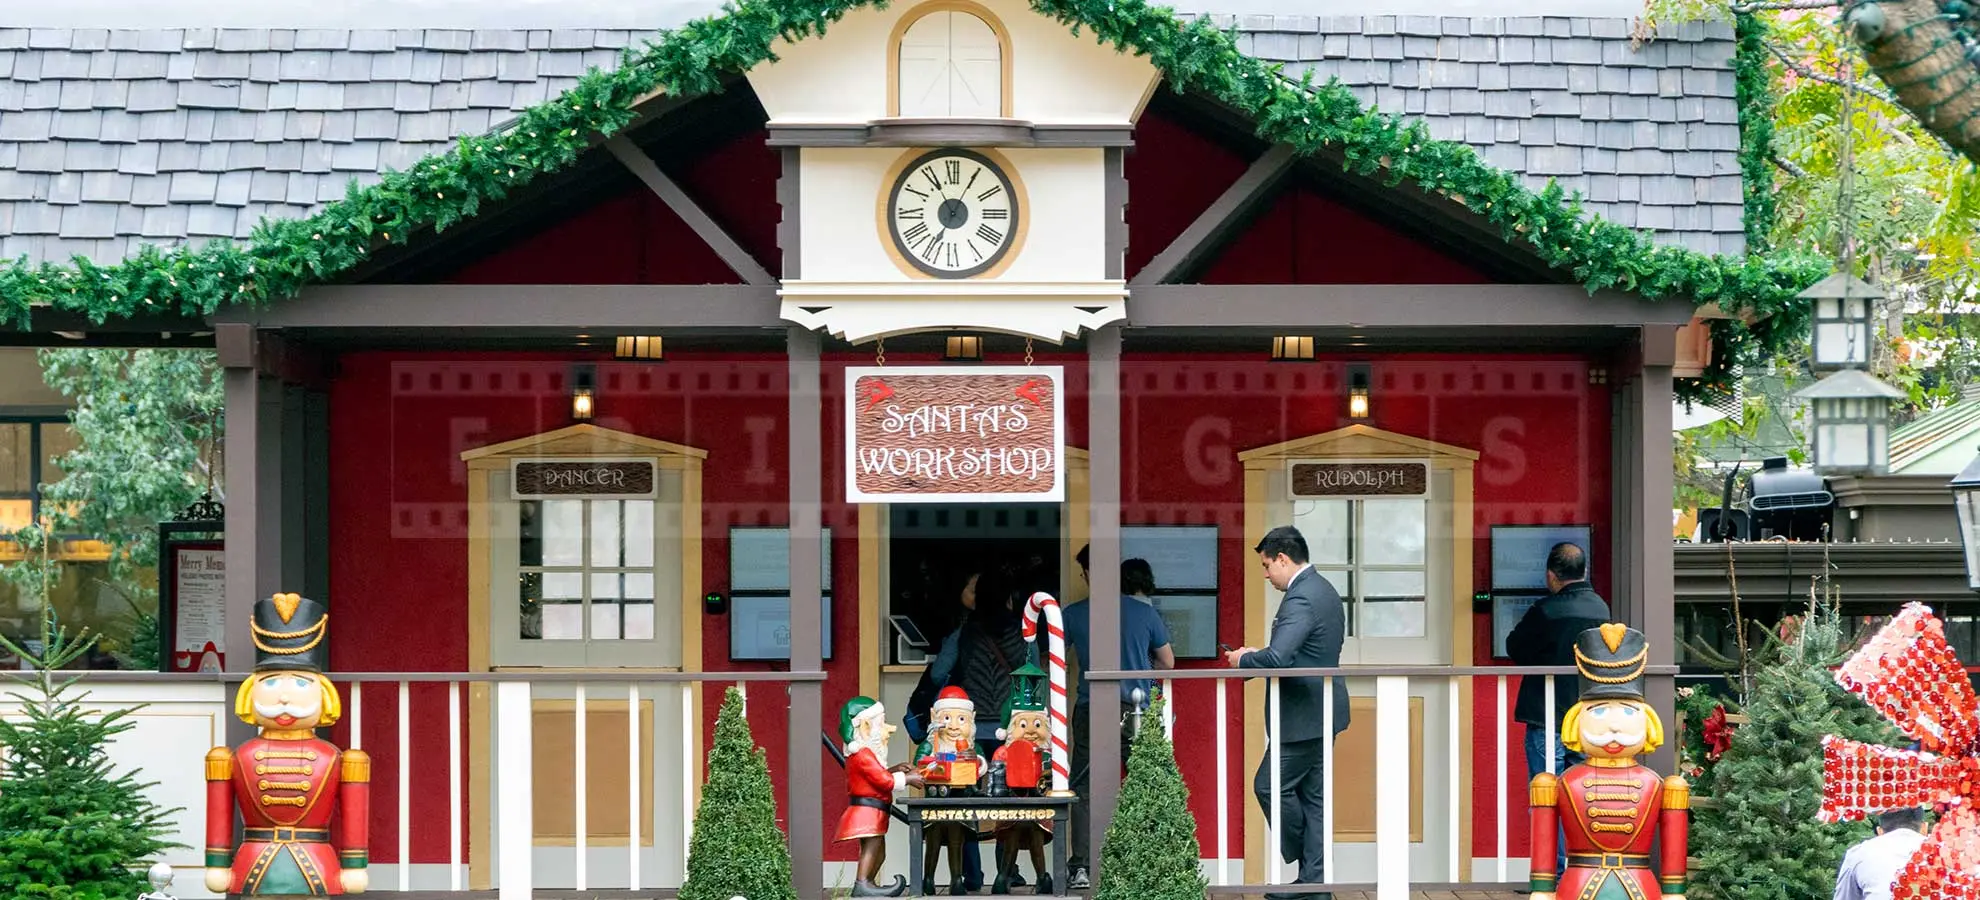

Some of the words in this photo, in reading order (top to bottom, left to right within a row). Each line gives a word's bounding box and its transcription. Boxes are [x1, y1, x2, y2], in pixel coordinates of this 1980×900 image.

[944, 160, 960, 185] XII
[978, 185, 1002, 202] II
[981, 208, 1007, 219] III
[882, 403, 1029, 439] SANTA'S
[859, 447, 1052, 481] WORKSHOP
[543, 468, 625, 488] DANCER
[1315, 469, 1404, 489] RUDOLPH
[180, 553, 203, 572] Merry
[921, 809, 974, 820] SANTA'S
[975, 809, 1056, 820] WORKSHOP
